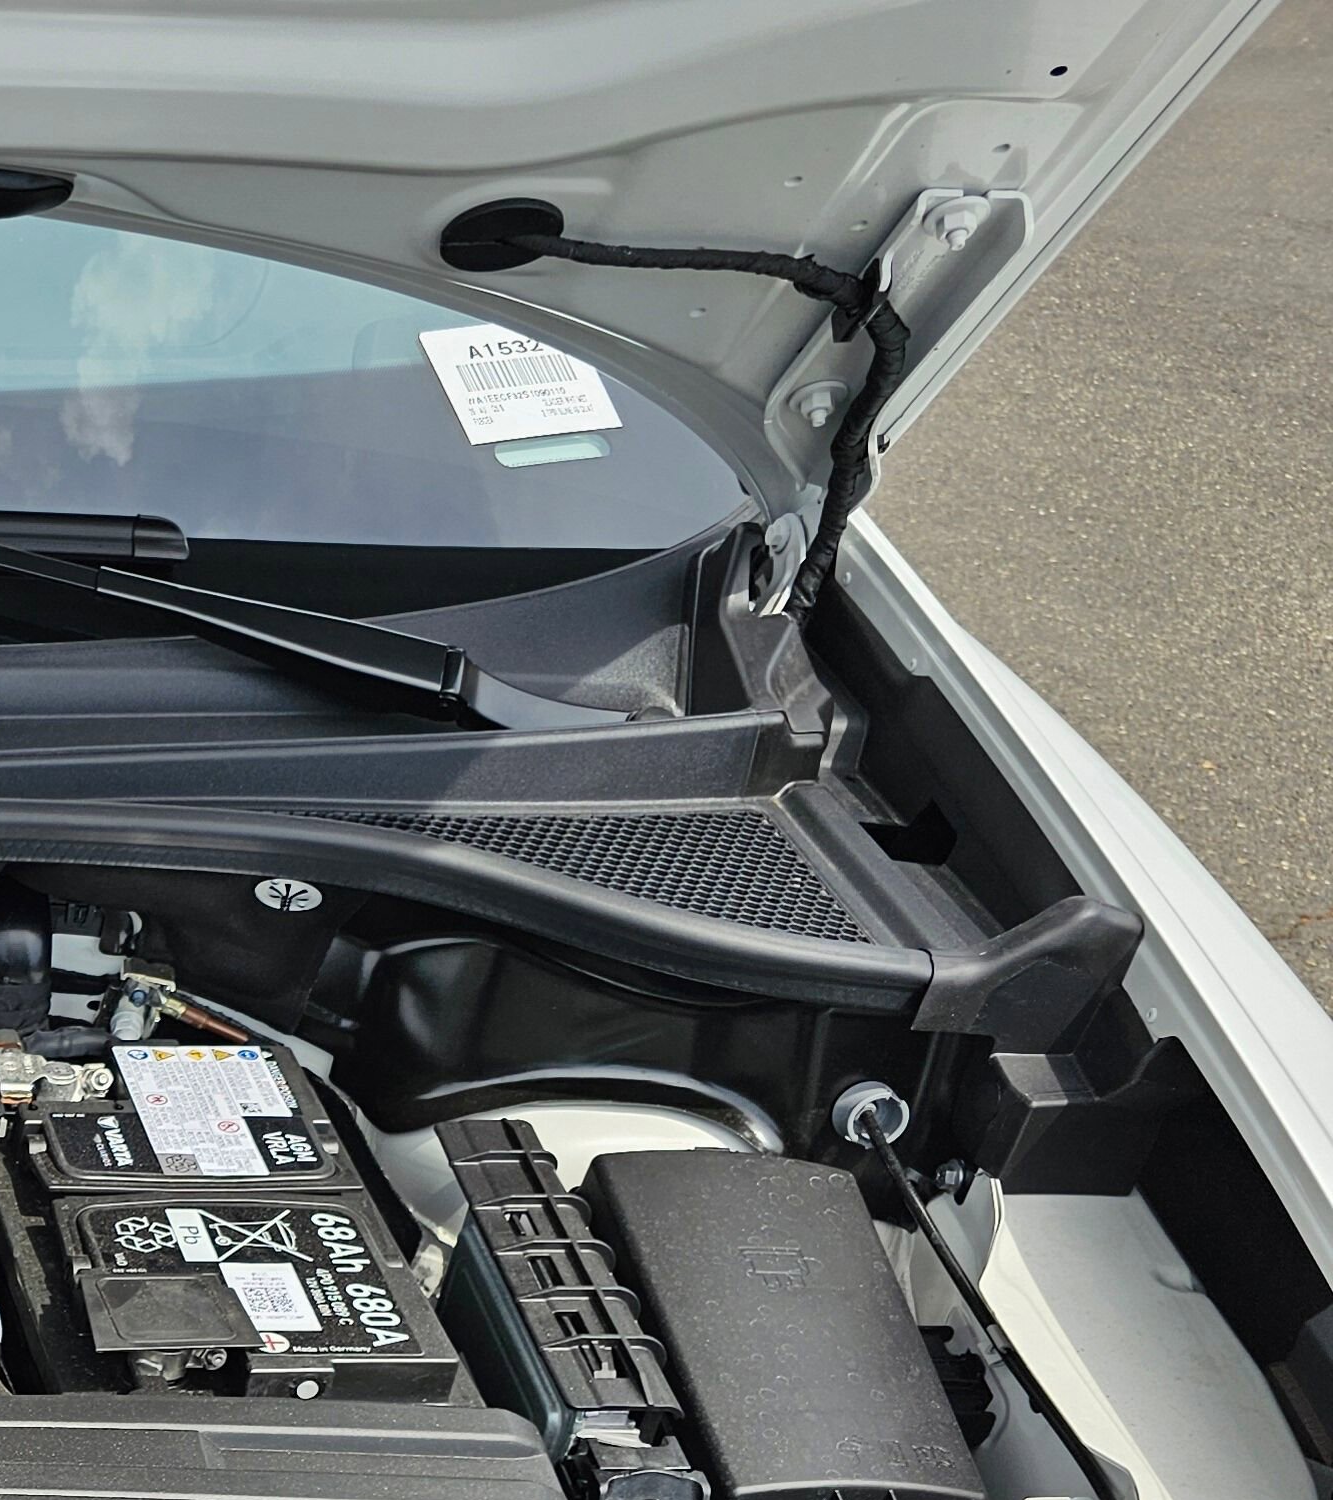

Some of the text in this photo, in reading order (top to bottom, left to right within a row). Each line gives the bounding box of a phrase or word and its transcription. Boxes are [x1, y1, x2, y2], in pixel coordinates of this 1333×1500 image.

[104, 1128, 133, 1166] VARTA
[263, 1131, 294, 1165] VRLA
[285, 1133, 318, 1162] AGM
[180, 1226, 199, 1245] Pb
[310, 1213, 410, 1347] 68Ah 680A
[323, 1286, 342, 1301] 915
